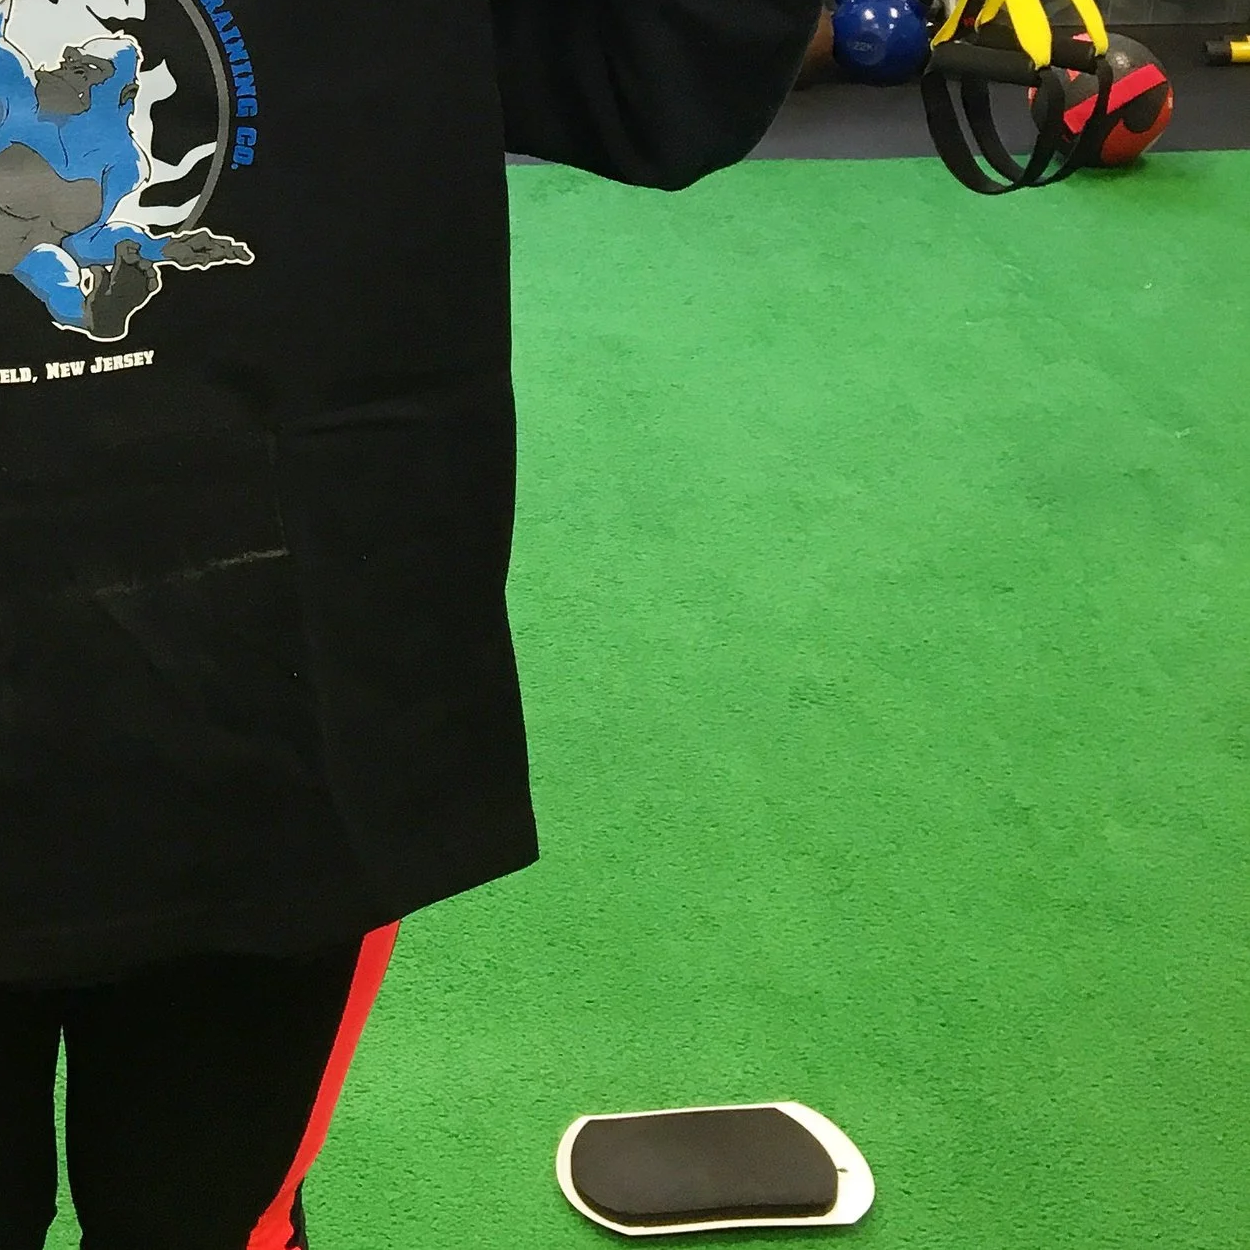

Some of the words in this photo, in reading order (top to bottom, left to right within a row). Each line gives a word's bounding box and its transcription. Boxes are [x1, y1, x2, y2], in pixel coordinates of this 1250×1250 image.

[231, 126, 258, 170] CO.
[45, 360, 86, 380] NEW
[90, 350, 155, 374] JERSEY
